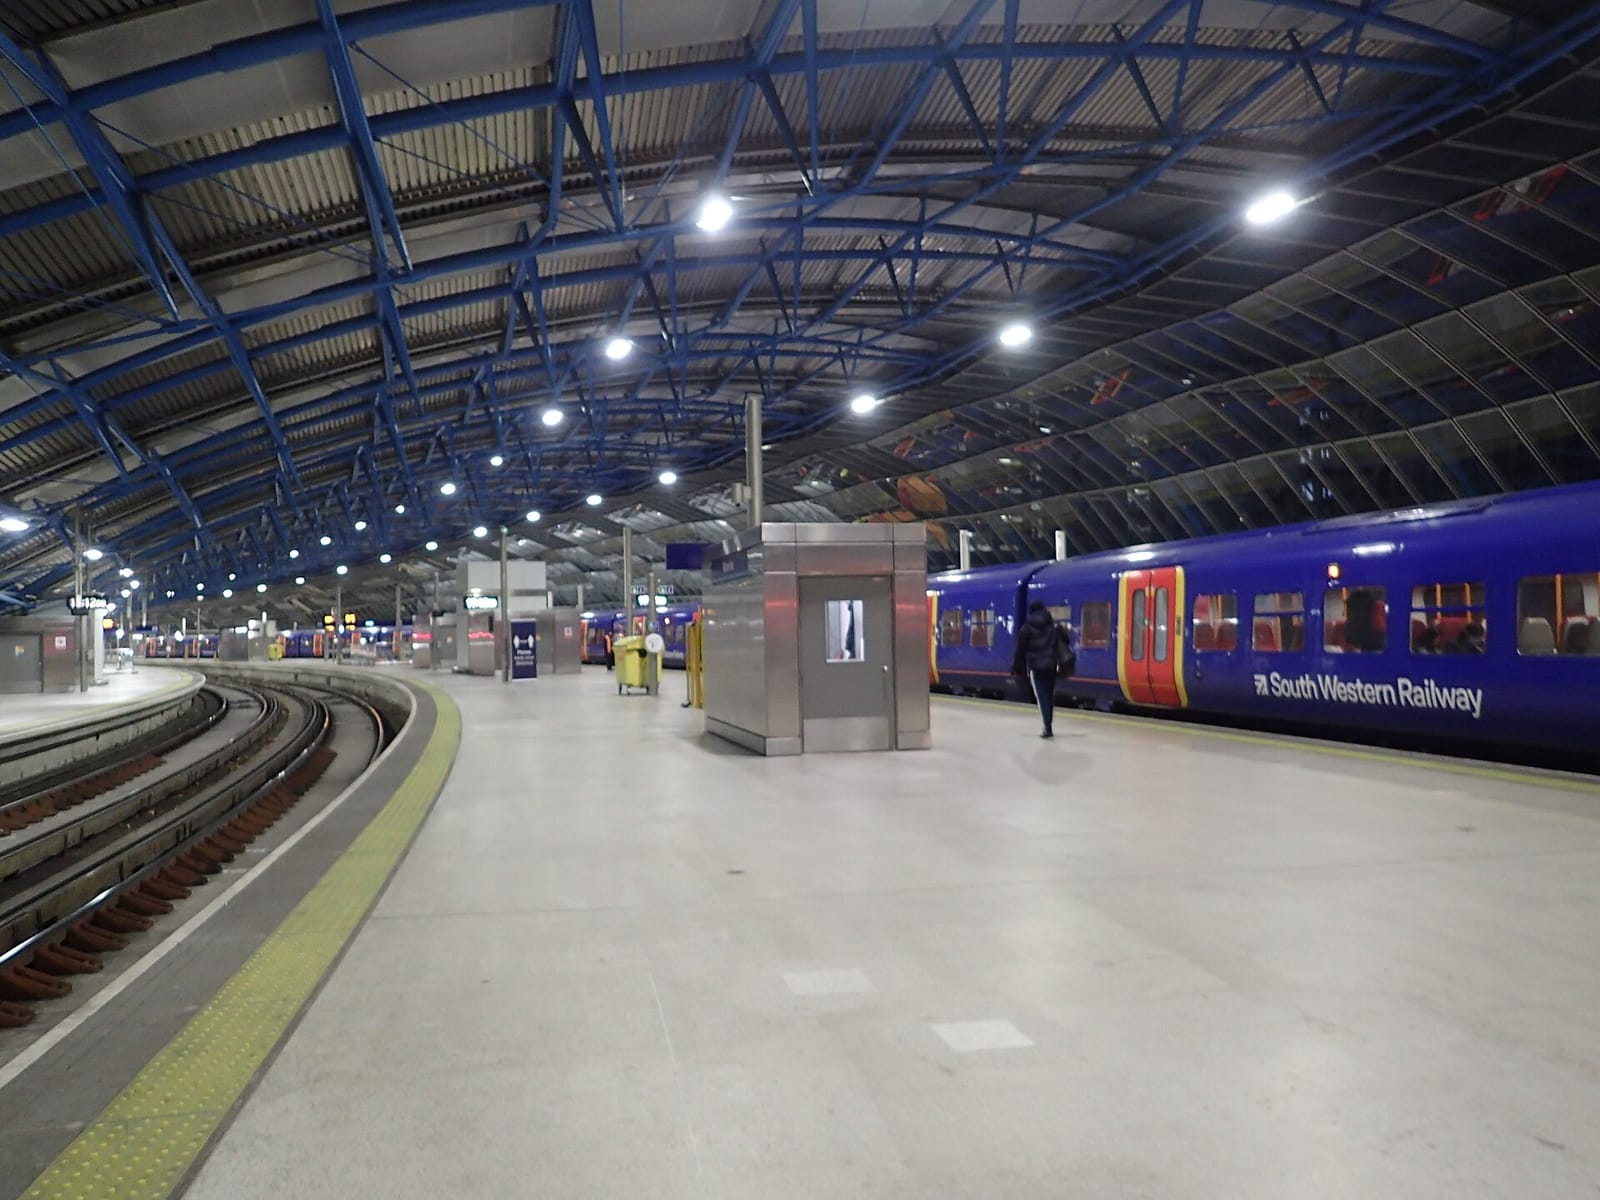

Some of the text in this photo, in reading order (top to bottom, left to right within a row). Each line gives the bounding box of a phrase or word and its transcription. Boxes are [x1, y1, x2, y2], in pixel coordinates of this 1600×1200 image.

[1270, 672, 1482, 719] South Western Railway
